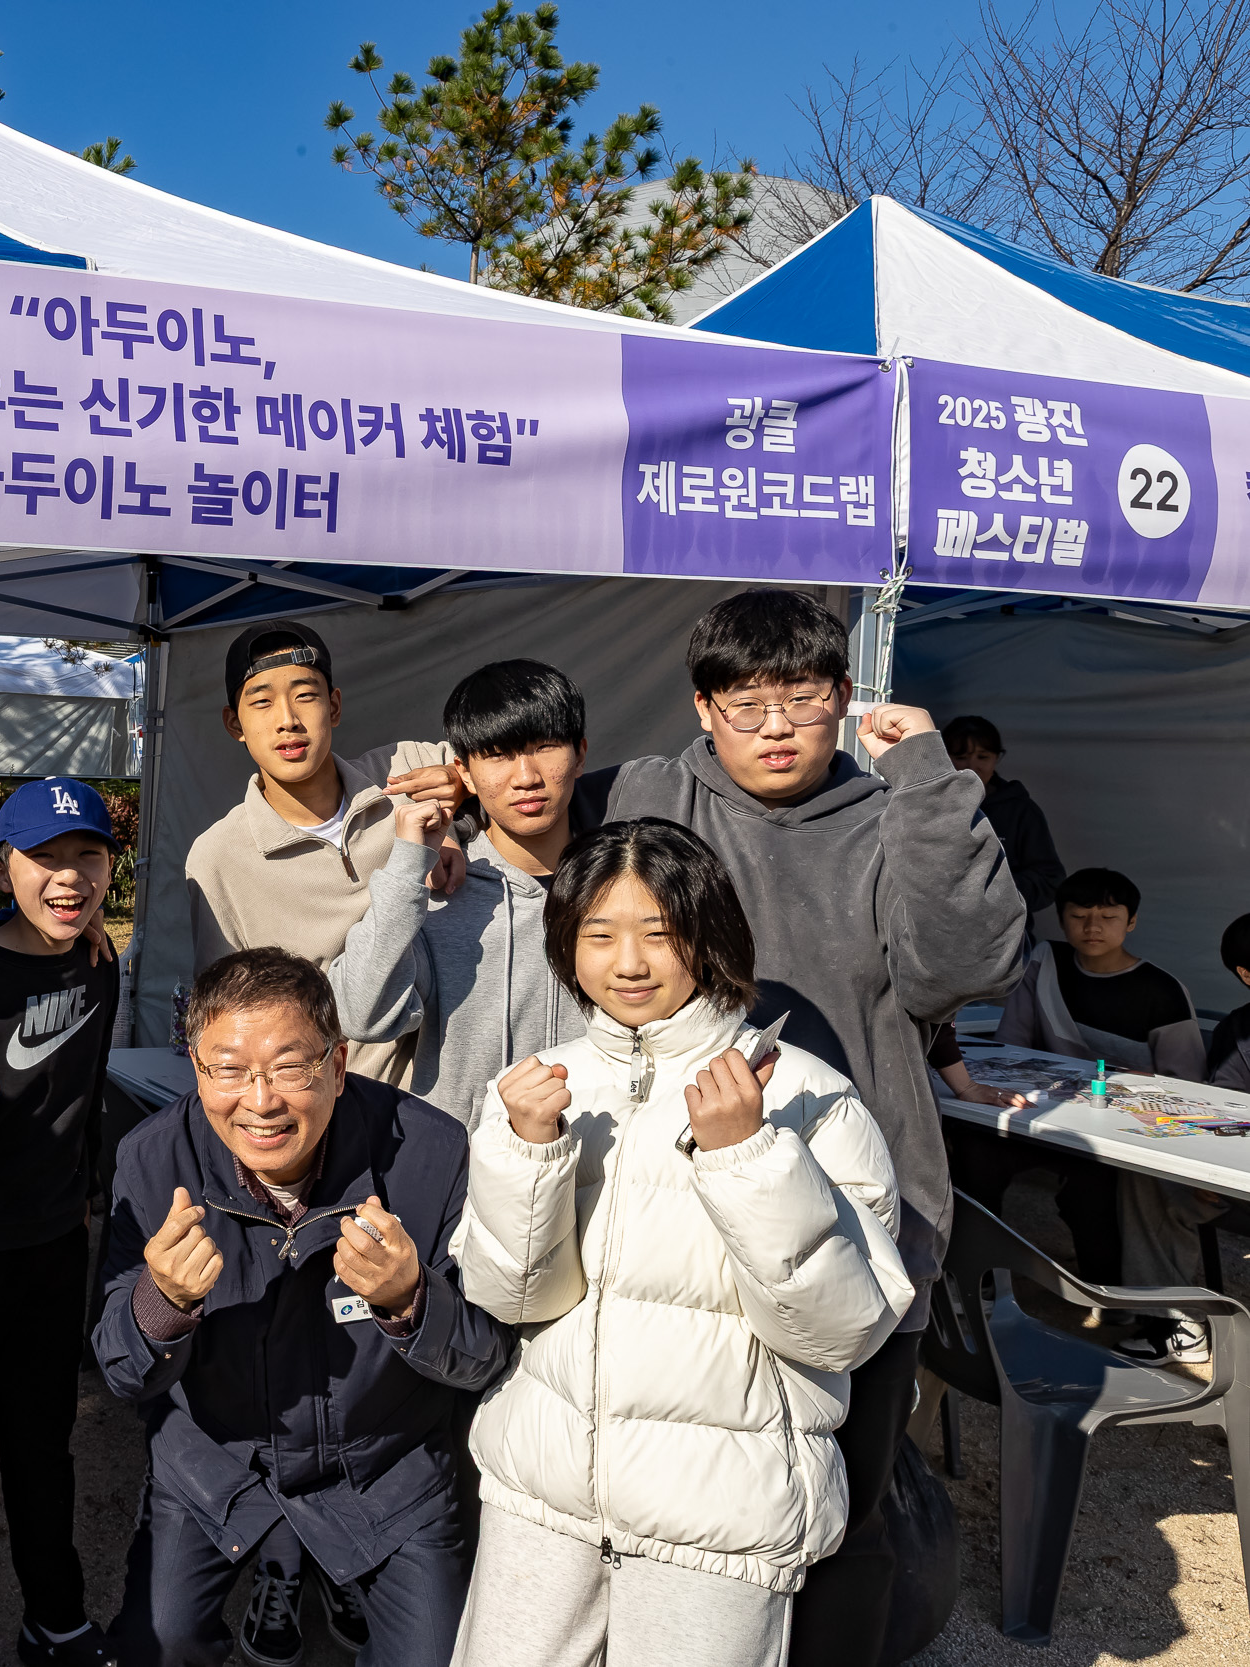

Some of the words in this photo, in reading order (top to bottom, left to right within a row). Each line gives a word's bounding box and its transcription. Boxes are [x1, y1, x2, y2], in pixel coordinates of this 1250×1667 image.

[78, 377, 242, 446] 신기한
[255, 393, 406, 459] 메이커
[725, 396, 799, 454] 광클
[937, 394, 1007, 430] 2025
[1011, 395, 1089, 447] 광진
[187, 462, 340, 534] 놀이터
[636, 460, 876, 527] 제로원코드랩
[957, 446, 1073, 506] 청소년
[1130, 467, 1180, 513] 22
[933, 508, 1089, 568] 페스티벌
[50, 786, 81, 816] LA
[22, 984, 87, 1037] NIKE
[630, 1080, 639, 1093] Lee
